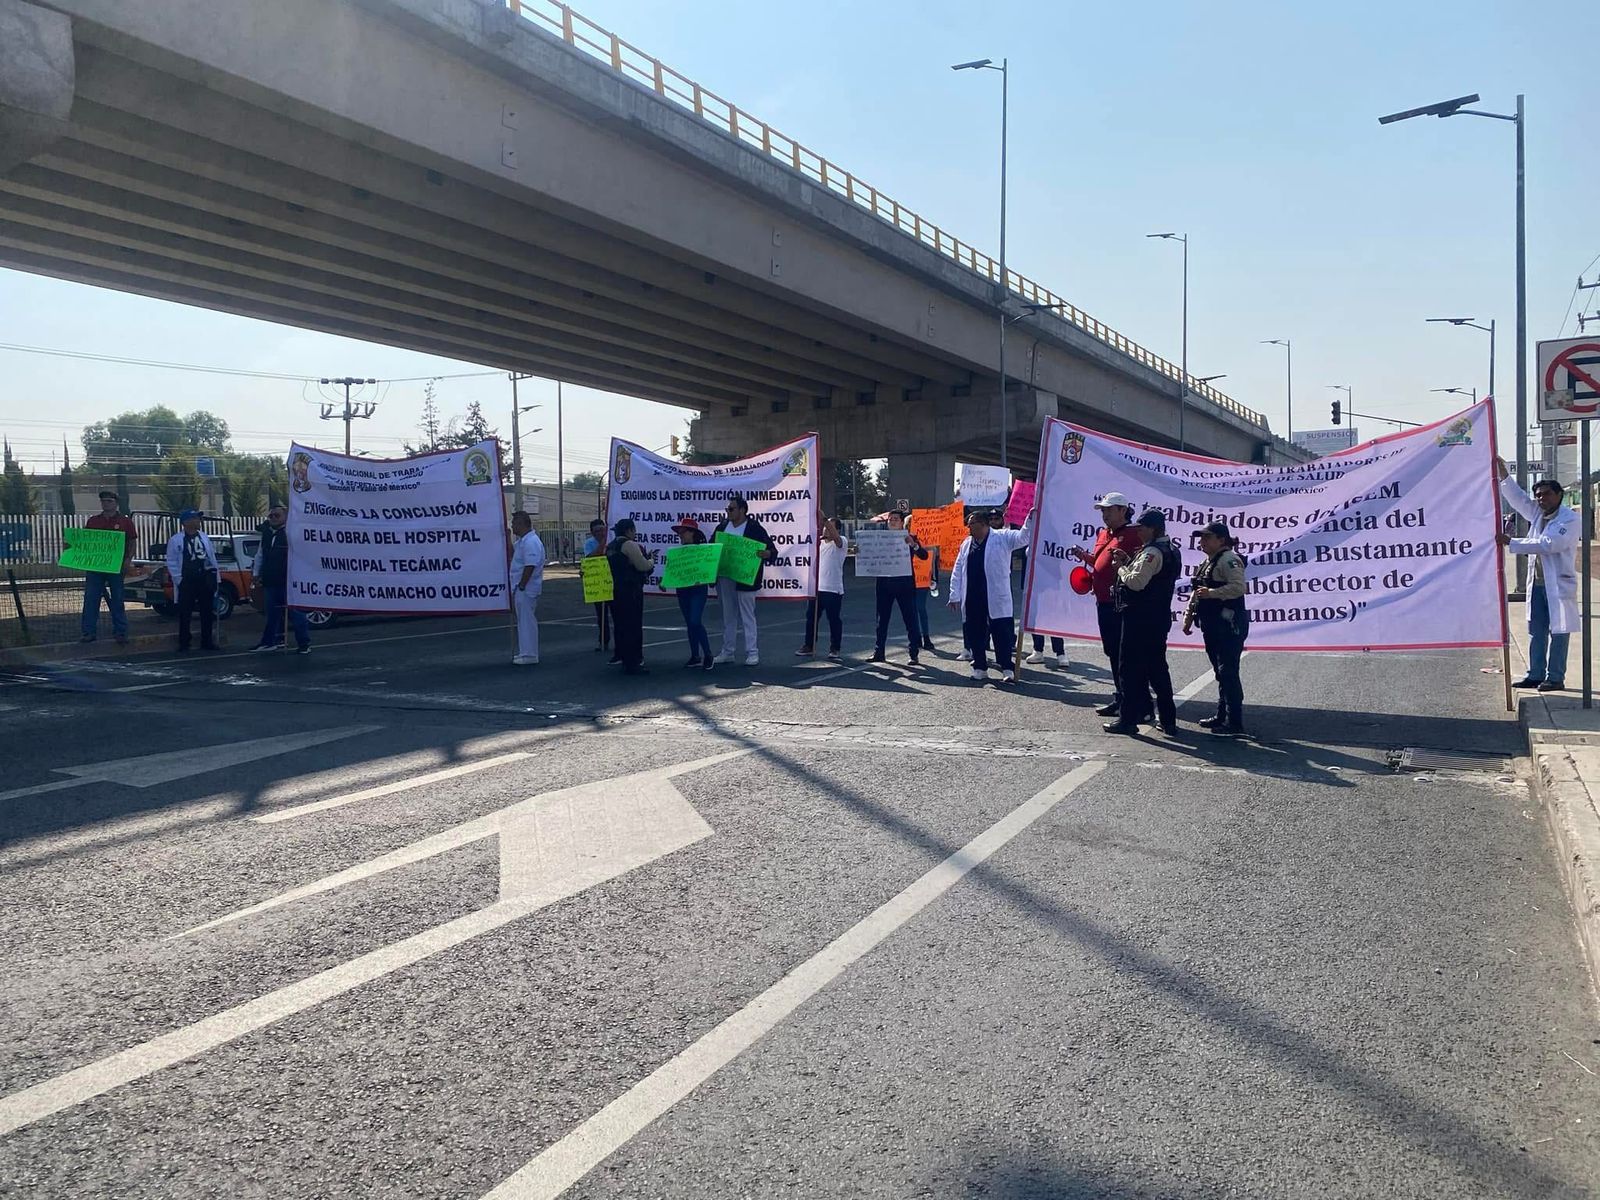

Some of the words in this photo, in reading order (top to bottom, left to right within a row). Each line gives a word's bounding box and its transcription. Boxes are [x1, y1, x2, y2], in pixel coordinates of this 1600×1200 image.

[378, 472, 391, 480] DE
[1181, 468, 1250, 479] NACIONAL
[1297, 470, 1346, 481] SALUD
[621, 490, 657, 501] EXIGIMOS
[659, 490, 671, 501] LA
[746, 489, 812, 501] INMEDIATA
[361, 508, 380, 520] LA
[382, 500, 478, 520] CONCLUSIÓN
[629, 511, 641, 521] DE
[642, 512, 653, 522] LA
[655, 512, 675, 523] DRA.
[1385, 507, 1426, 529] del
[303, 528, 317, 542] DE
[319, 529, 334, 543] LA
[336, 530, 371, 545] OBRA
[374, 531, 401, 545] DEL
[404, 529, 481, 545] HOSPITAL
[770, 534, 794, 545] POR
[797, 534, 813, 545] LA
[1315, 537, 1473, 564] Bustamante
[320, 556, 387, 572] MUNICIPAL
[389, 555, 462, 573] TECÁMAC
[795, 556, 811, 567] EN
[1382, 569, 1414, 589] de
[300, 581, 322, 596] LIC.
[325, 583, 366, 599] CESAR
[368, 582, 437, 600] CAMACHO
